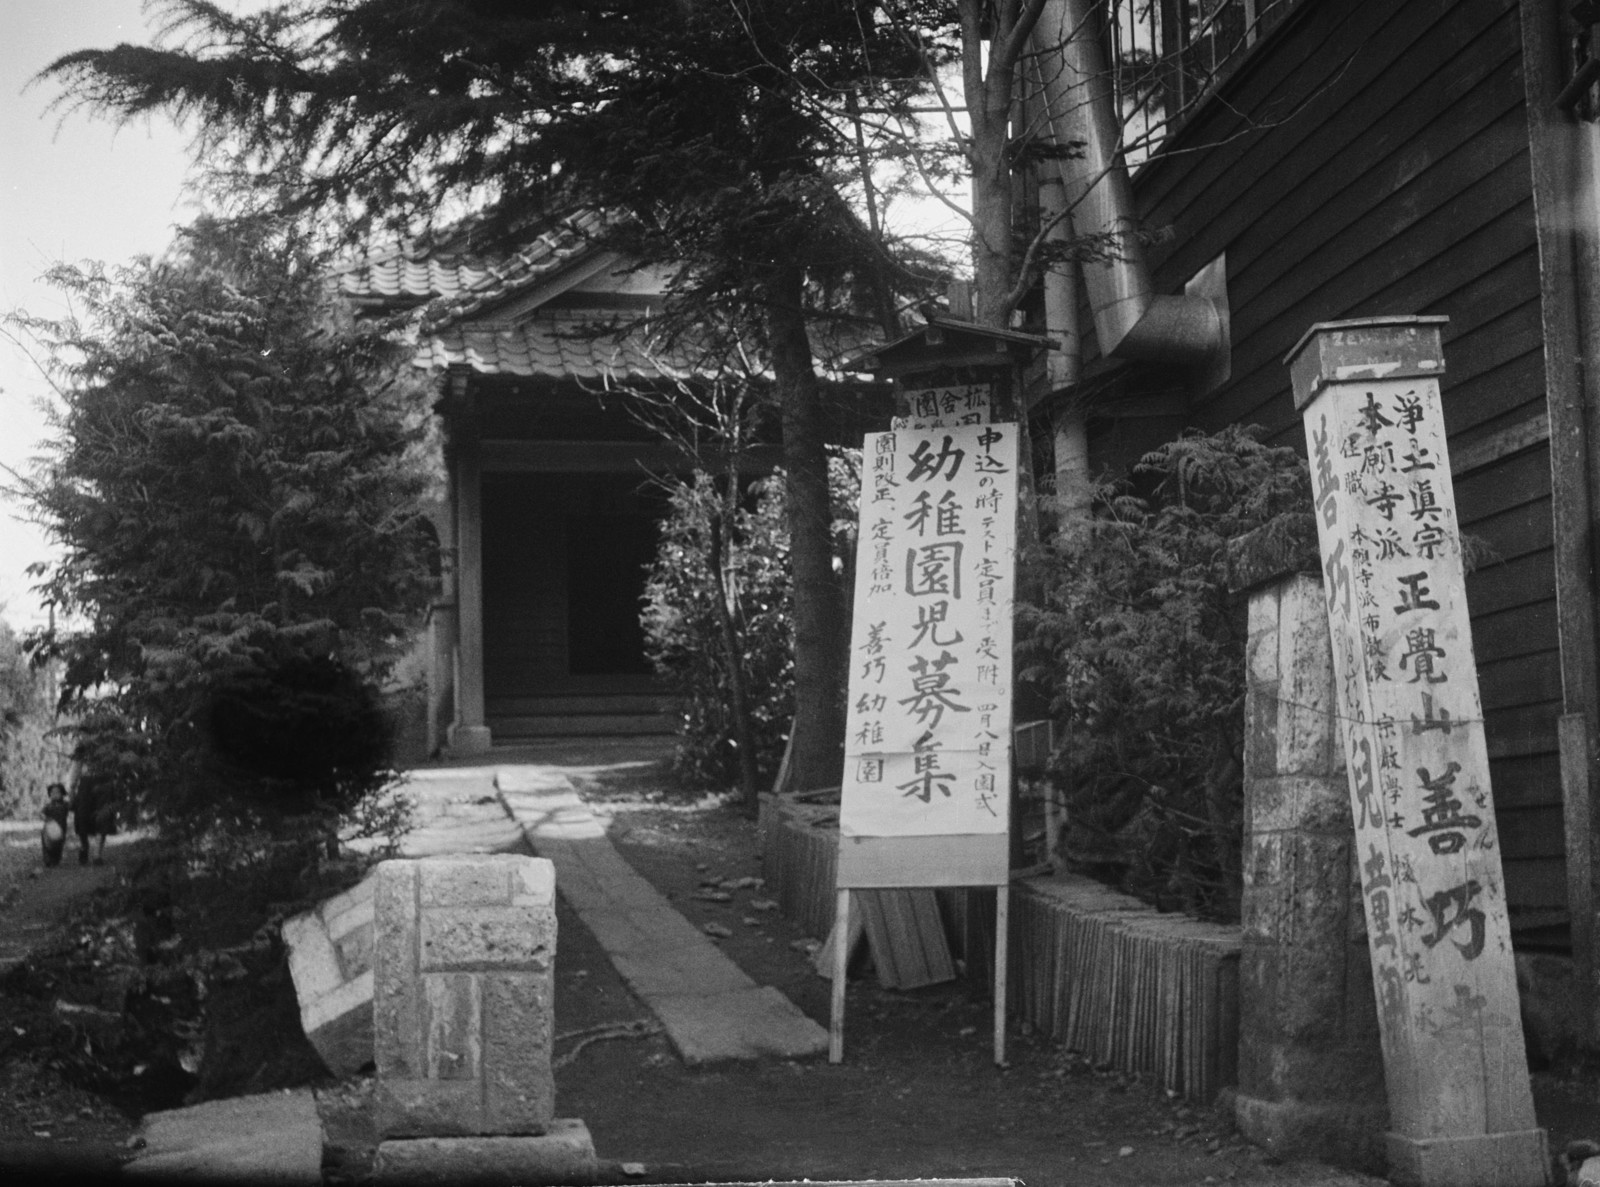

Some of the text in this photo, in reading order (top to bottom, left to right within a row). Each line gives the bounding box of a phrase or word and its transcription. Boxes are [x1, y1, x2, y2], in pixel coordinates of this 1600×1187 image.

[855, 620, 893, 784] 善巧幼稚園
[895, 434, 973, 804] 幼稚園児募集
